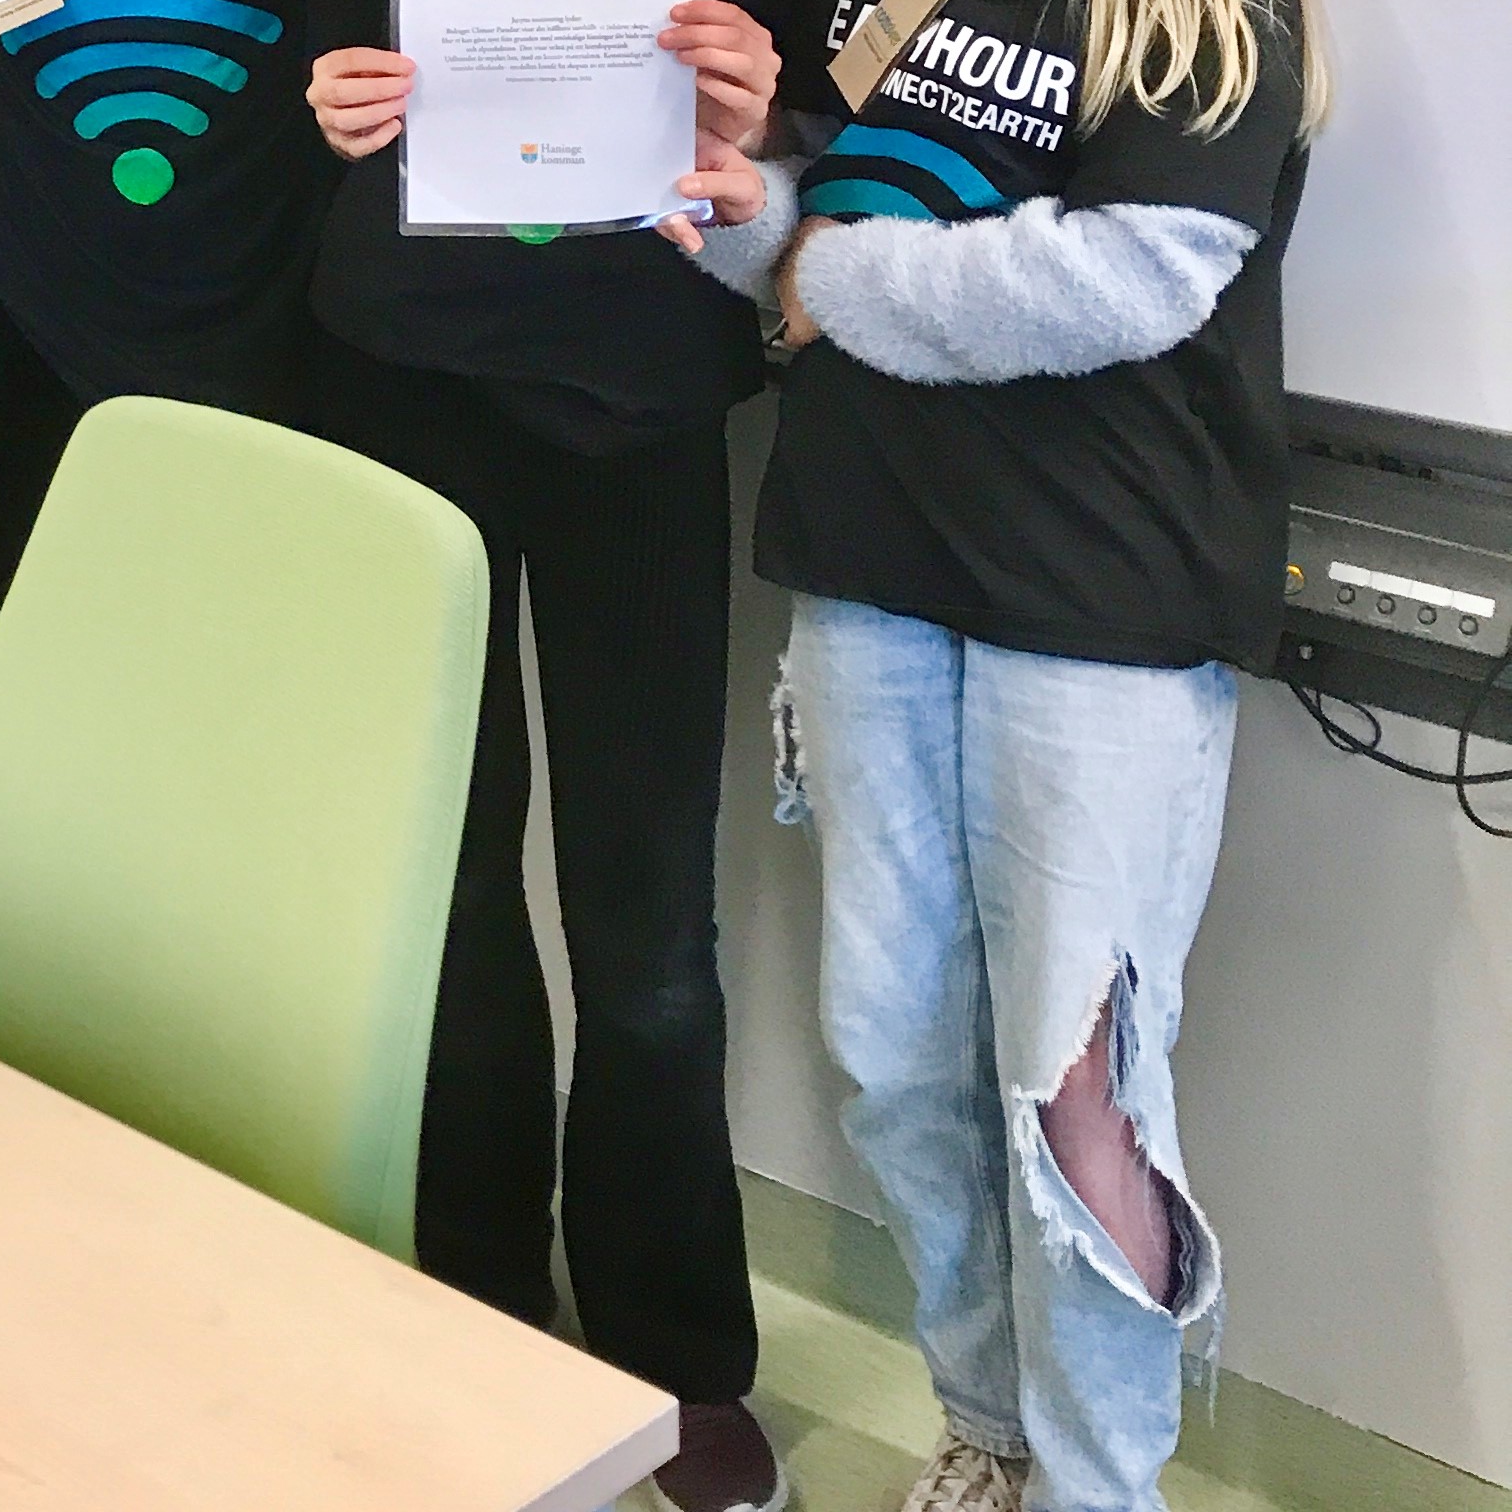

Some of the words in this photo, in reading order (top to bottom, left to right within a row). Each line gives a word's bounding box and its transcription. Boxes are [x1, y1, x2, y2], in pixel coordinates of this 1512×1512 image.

[923, 17, 1078, 116] HOUR
[541, 143, 582, 156] Haninge
[541, 155, 586, 165] kommun
